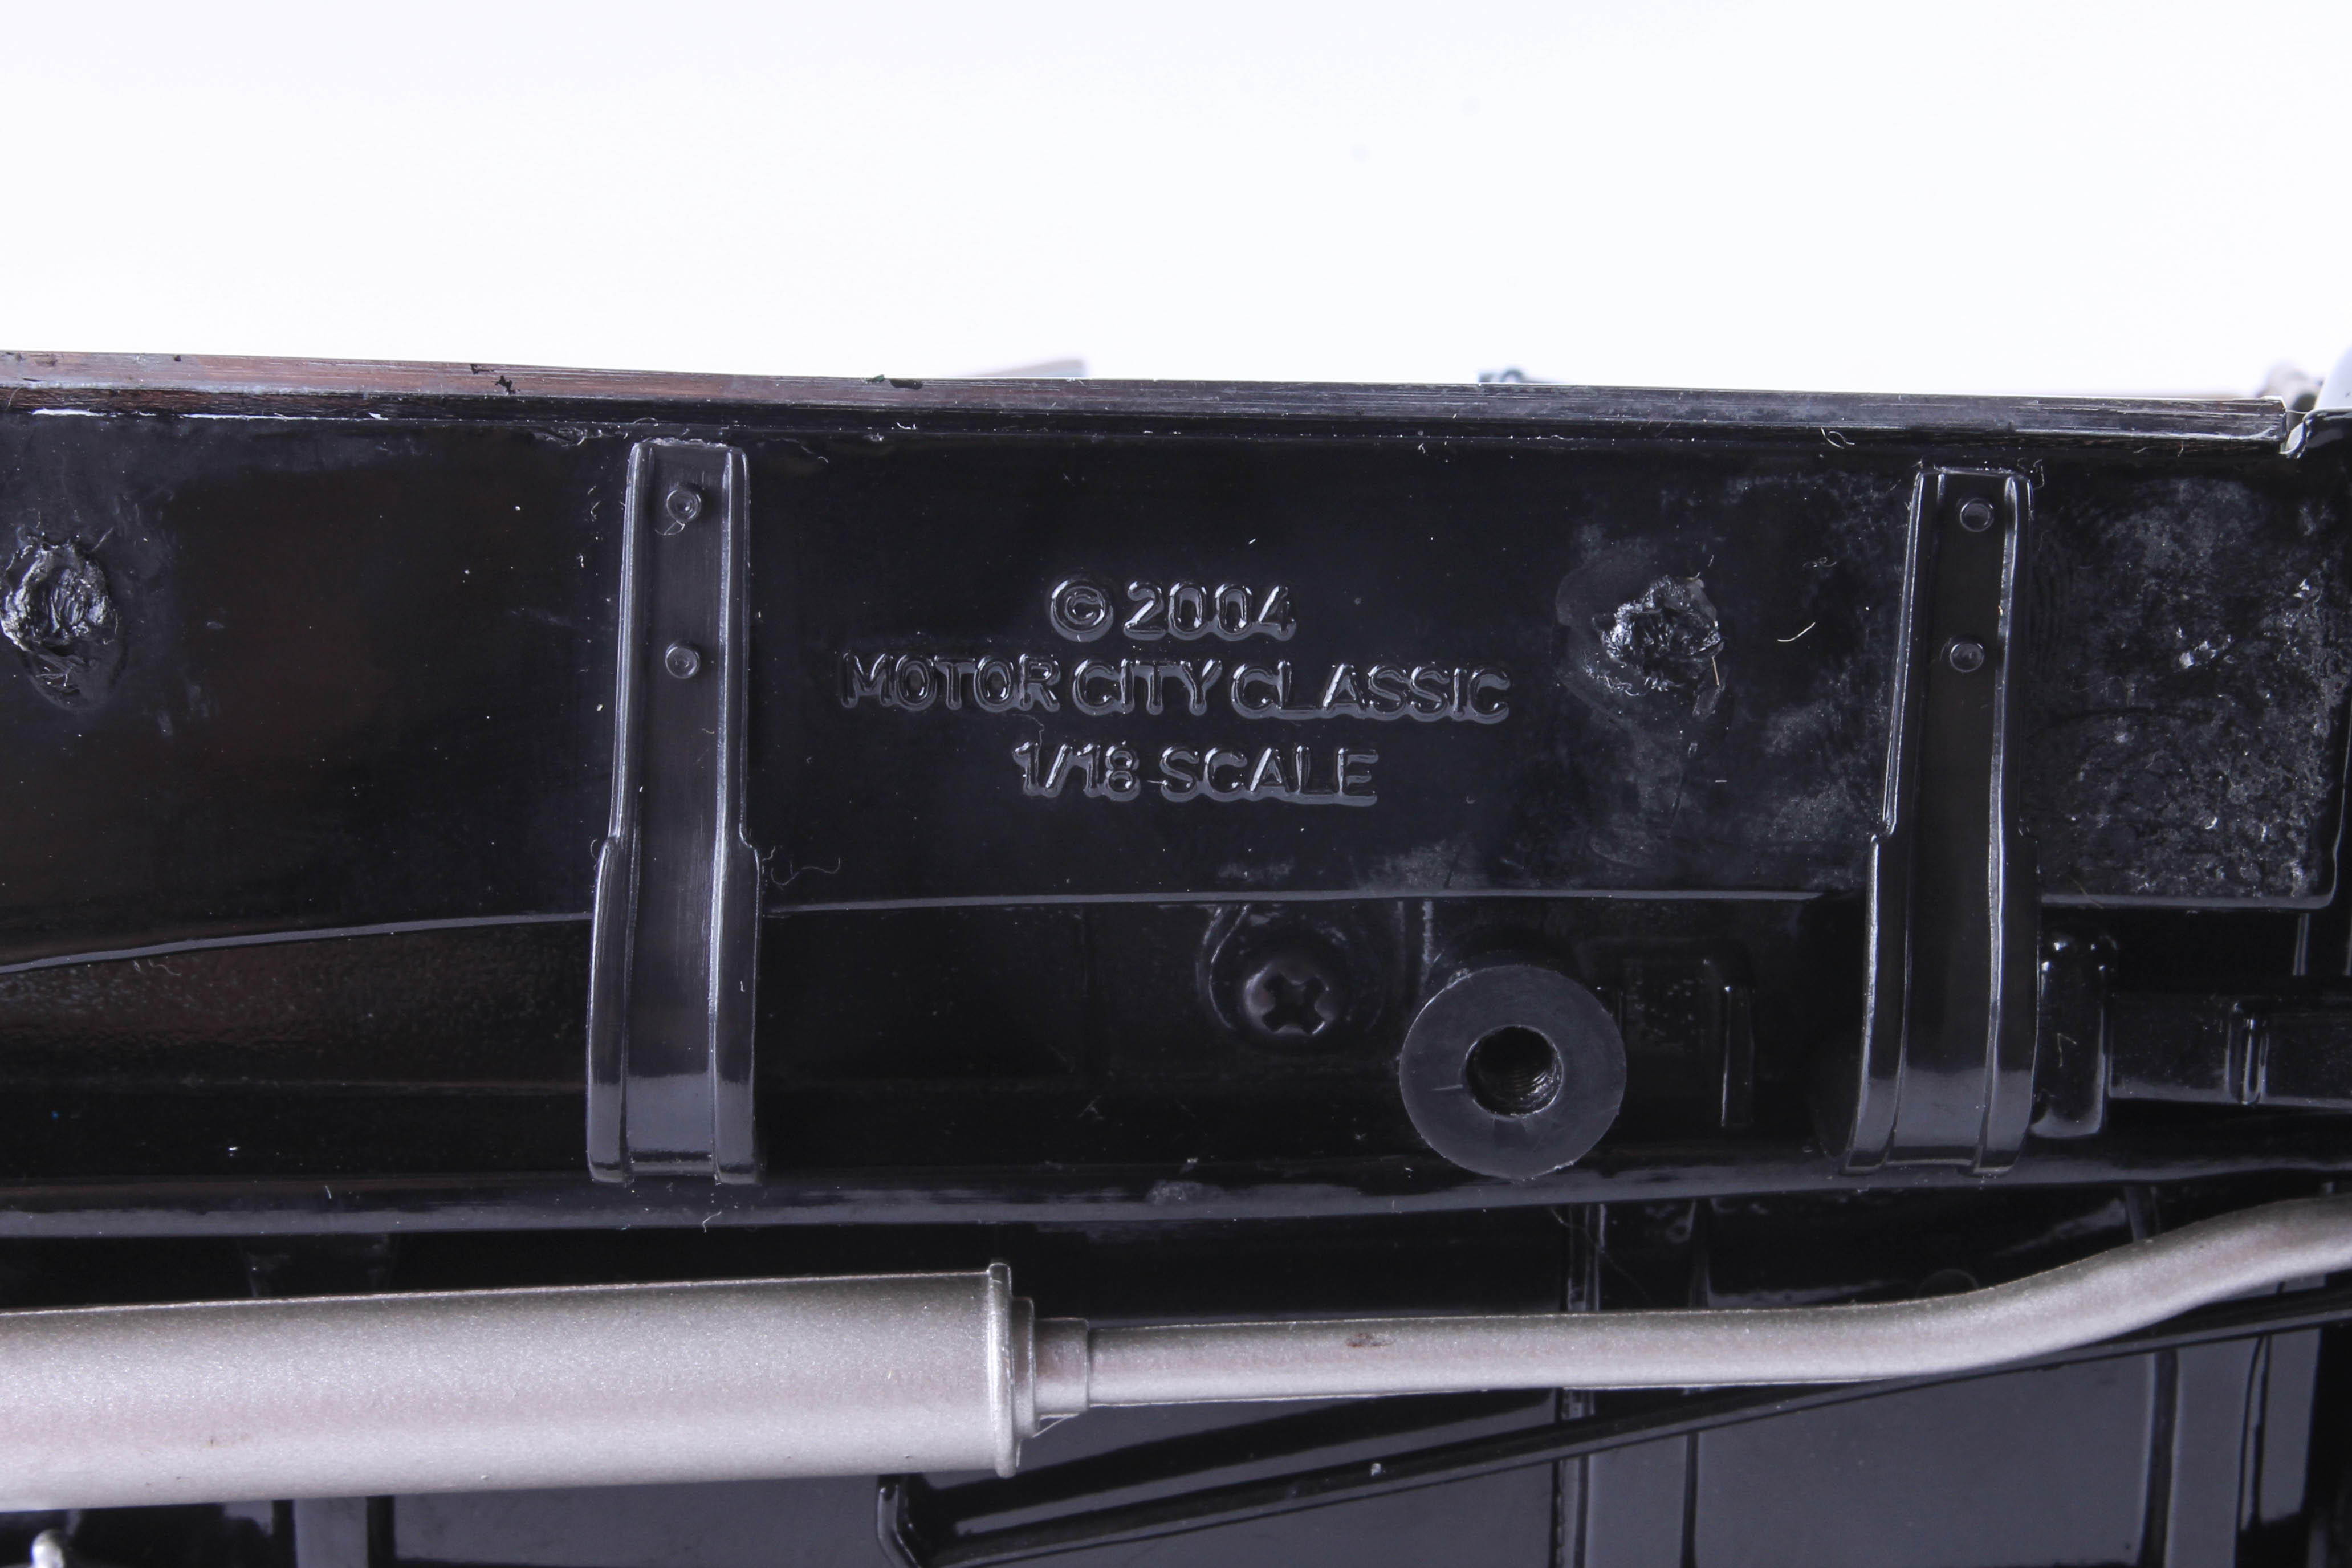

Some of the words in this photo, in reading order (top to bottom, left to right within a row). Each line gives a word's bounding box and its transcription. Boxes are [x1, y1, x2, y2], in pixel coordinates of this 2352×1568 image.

[1123, 580, 1296, 640] 2004
[841, 651, 1061, 712] MOTOR
[1073, 659, 1223, 716] CITY
[1231, 660, 1511, 723] CLASSIC
[1014, 741, 1139, 800] 1/18
[1160, 744, 1378, 805] SCALE
